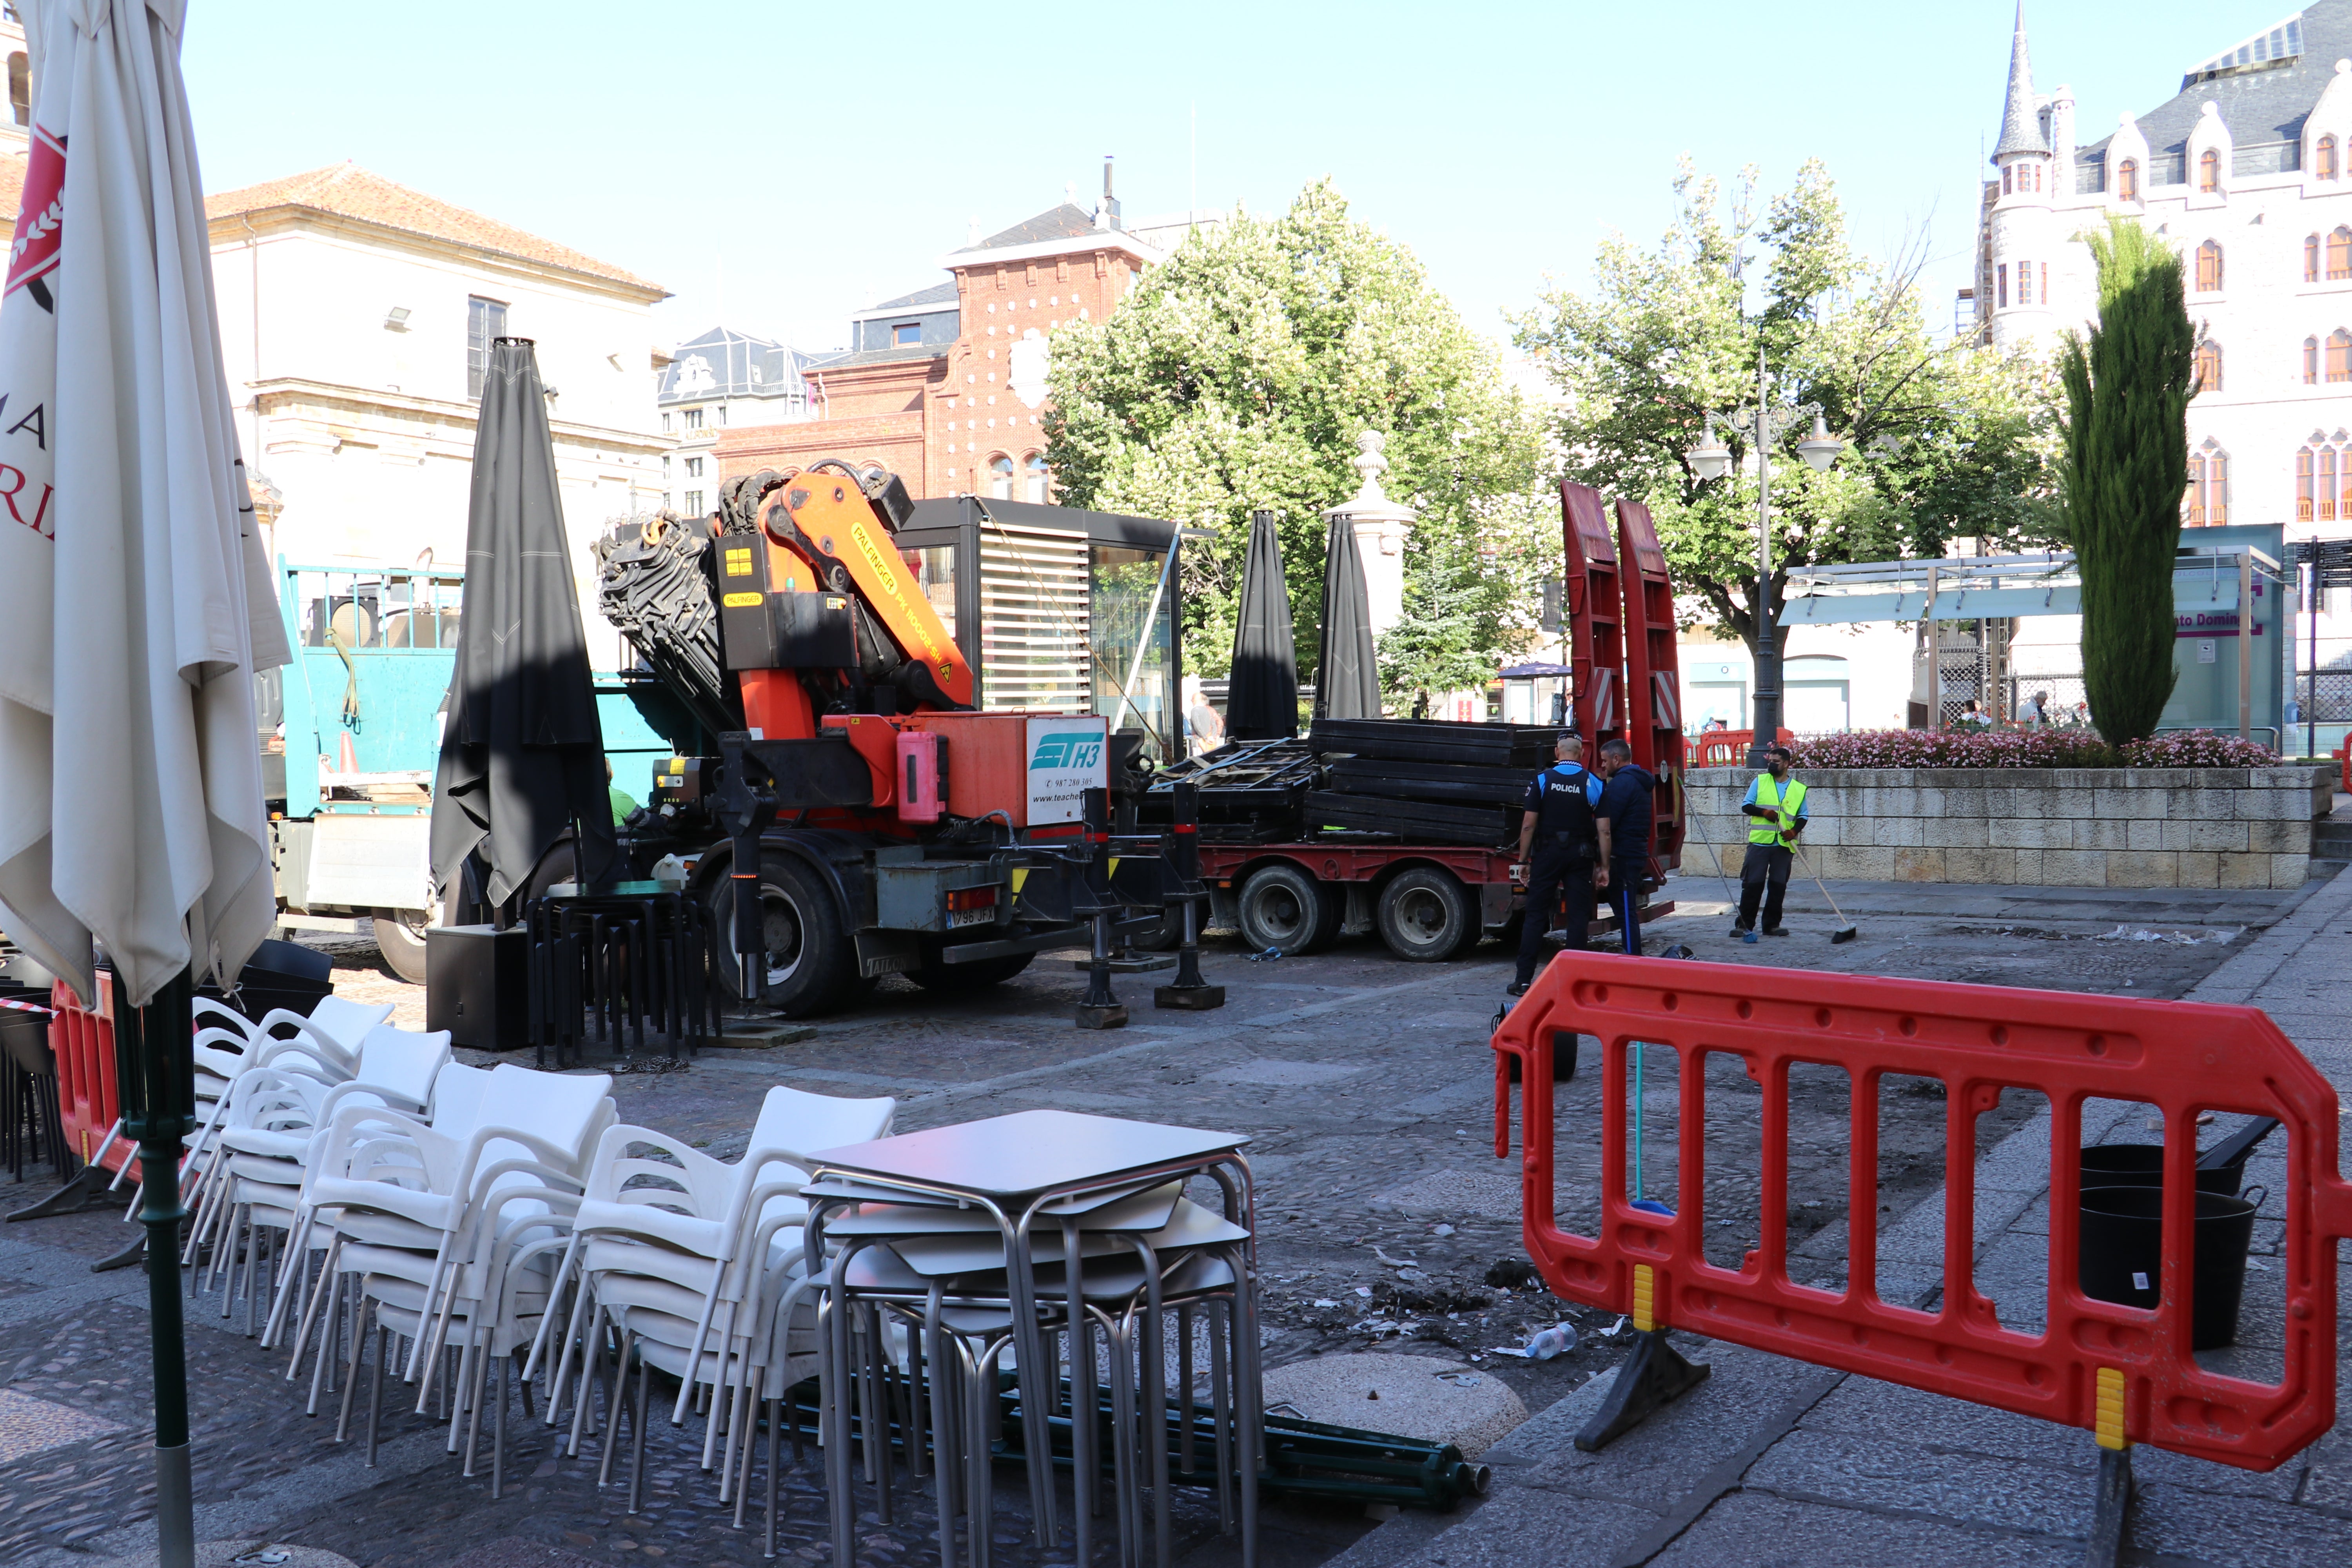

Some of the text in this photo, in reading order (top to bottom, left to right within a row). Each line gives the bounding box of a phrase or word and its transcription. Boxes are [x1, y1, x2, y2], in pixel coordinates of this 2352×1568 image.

[854, 527, 894, 590] PALFINGER
[727, 595, 759, 604] PALFINGER
[895, 593, 908, 611] PK
[1551, 783, 1580, 794] POLICÍA
[1033, 793, 1078, 802] www.teache
[953, 907, 993, 926] 1796 JFX
